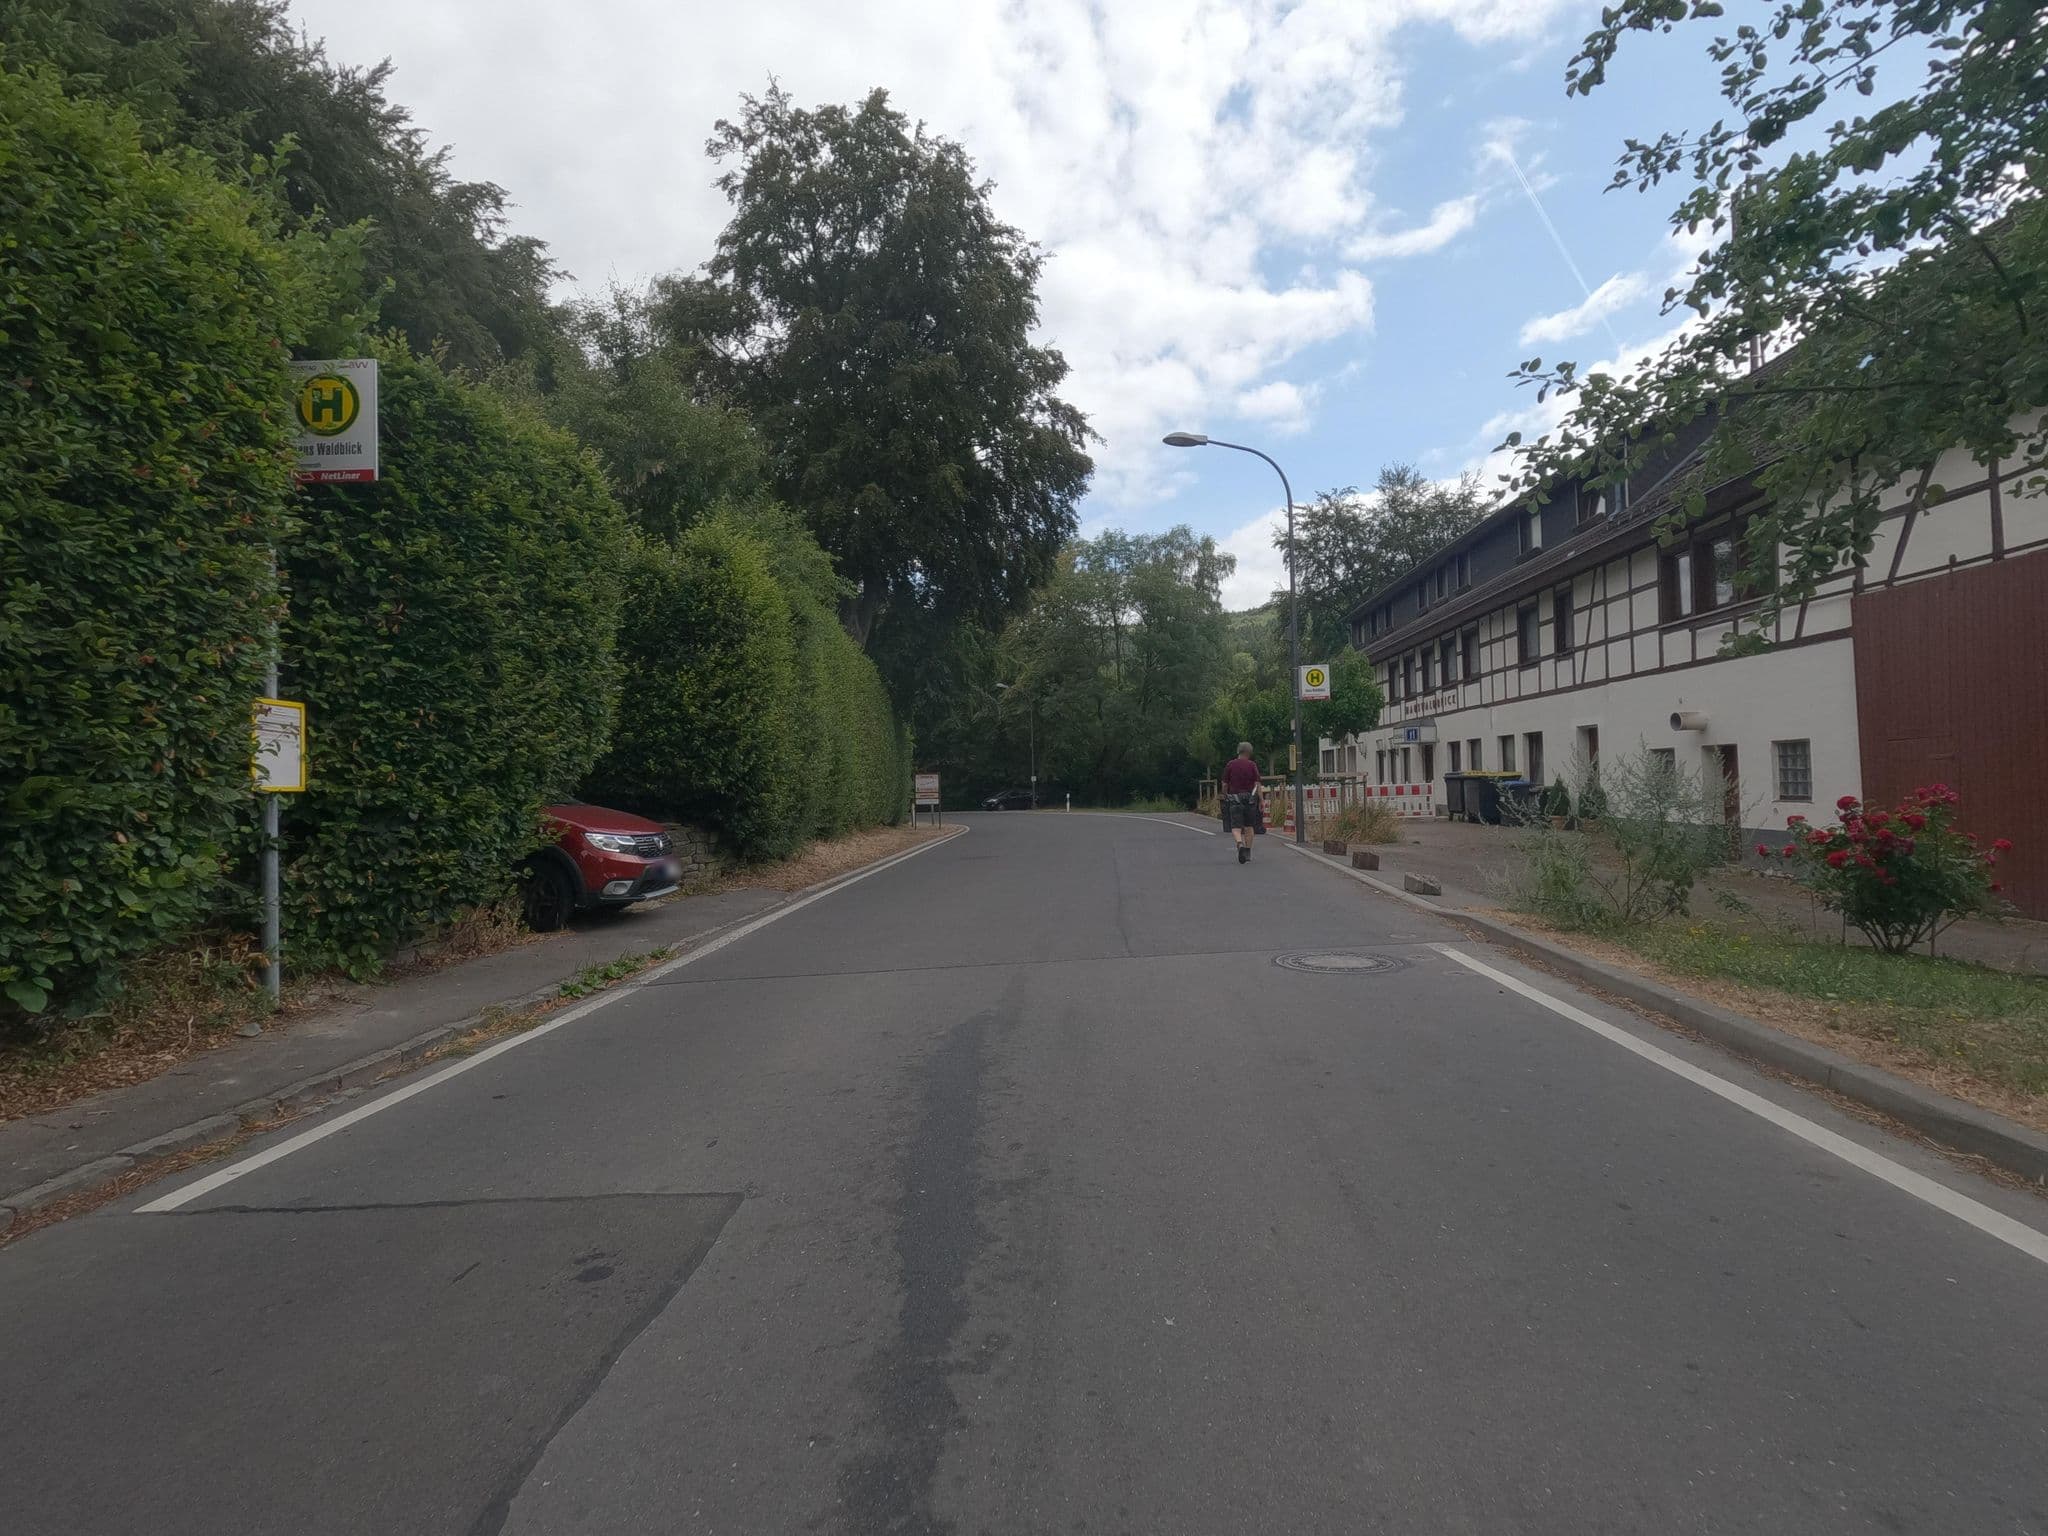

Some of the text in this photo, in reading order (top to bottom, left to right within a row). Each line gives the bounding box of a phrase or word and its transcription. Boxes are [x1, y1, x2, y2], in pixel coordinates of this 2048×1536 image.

[311, 387, 343, 423] H
[316, 441, 363, 456] Waldblick
[320, 471, 361, 481] NetLiner
[1310, 672, 1321, 683] H
